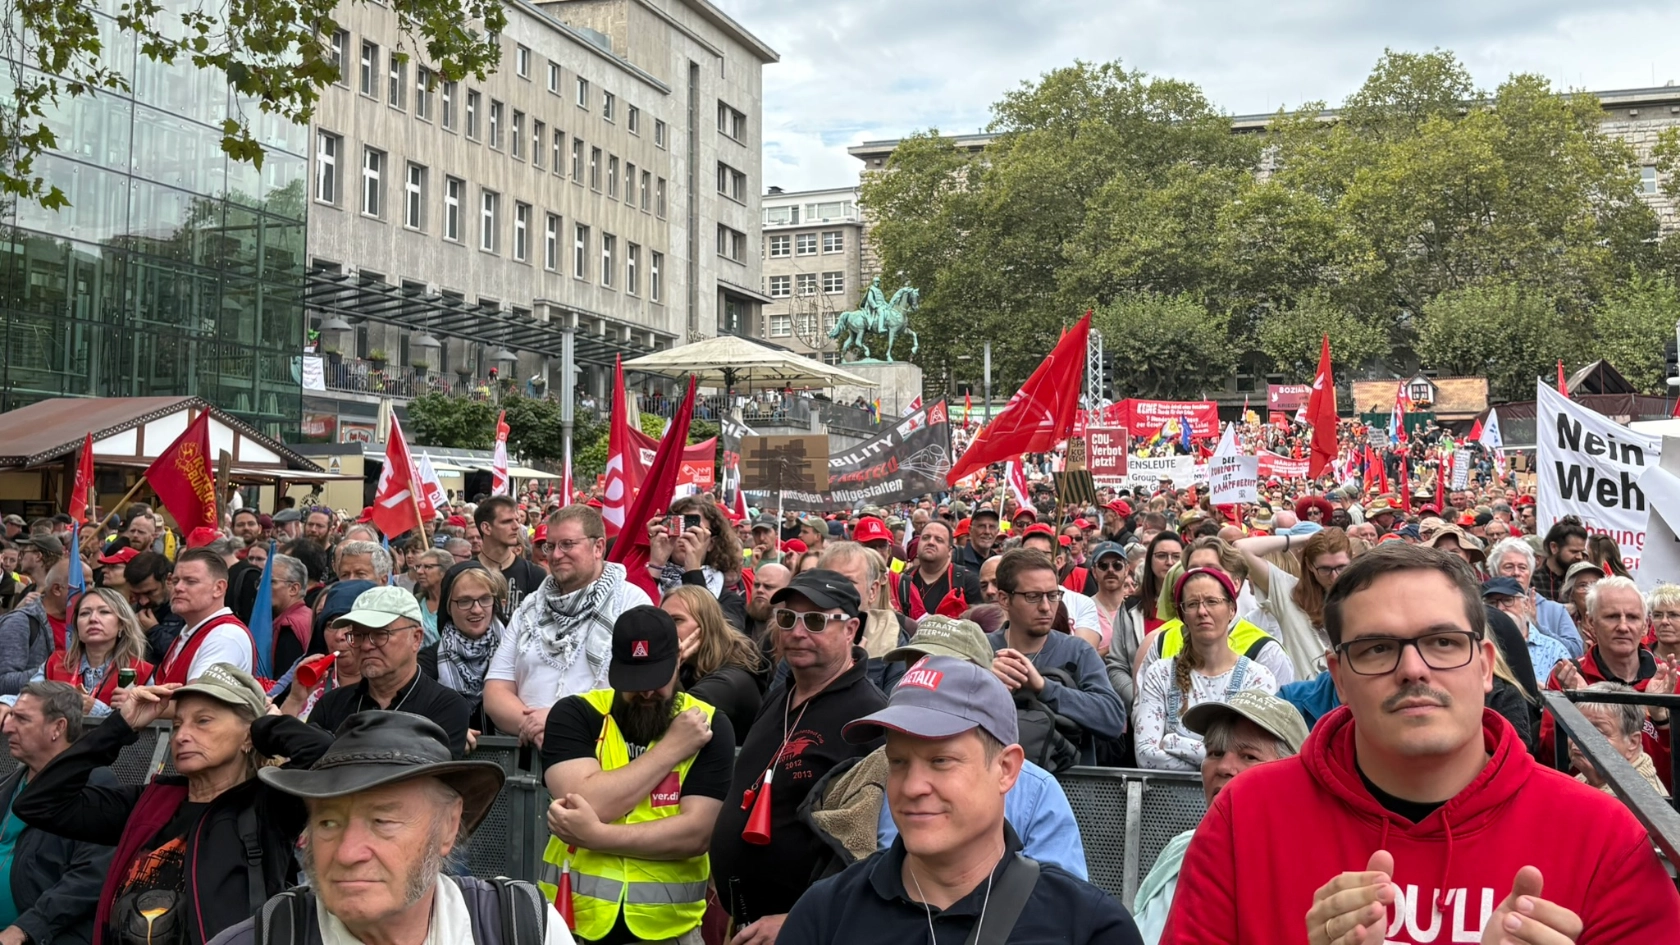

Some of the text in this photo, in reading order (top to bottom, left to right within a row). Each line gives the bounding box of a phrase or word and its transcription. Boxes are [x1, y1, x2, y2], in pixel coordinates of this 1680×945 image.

[1091, 433, 1114, 444] CDU-
[1557, 412, 1645, 466] Nein
[828, 433, 894, 467] BILITY
[1091, 444, 1122, 455] Verbot
[1091, 455, 1116, 469] jetzt!
[1222, 457, 1235, 465] DER
[193, 454, 215, 504] ROTER
[1132, 473, 1157, 482] Group
[1222, 473, 1232, 481] IST
[831, 478, 903, 503] Mitgestalten
[1555, 461, 1645, 511] Weh
[785, 759, 802, 770] 2012
[793, 770, 813, 779] 2013
[652, 791, 679, 801] ver.di
